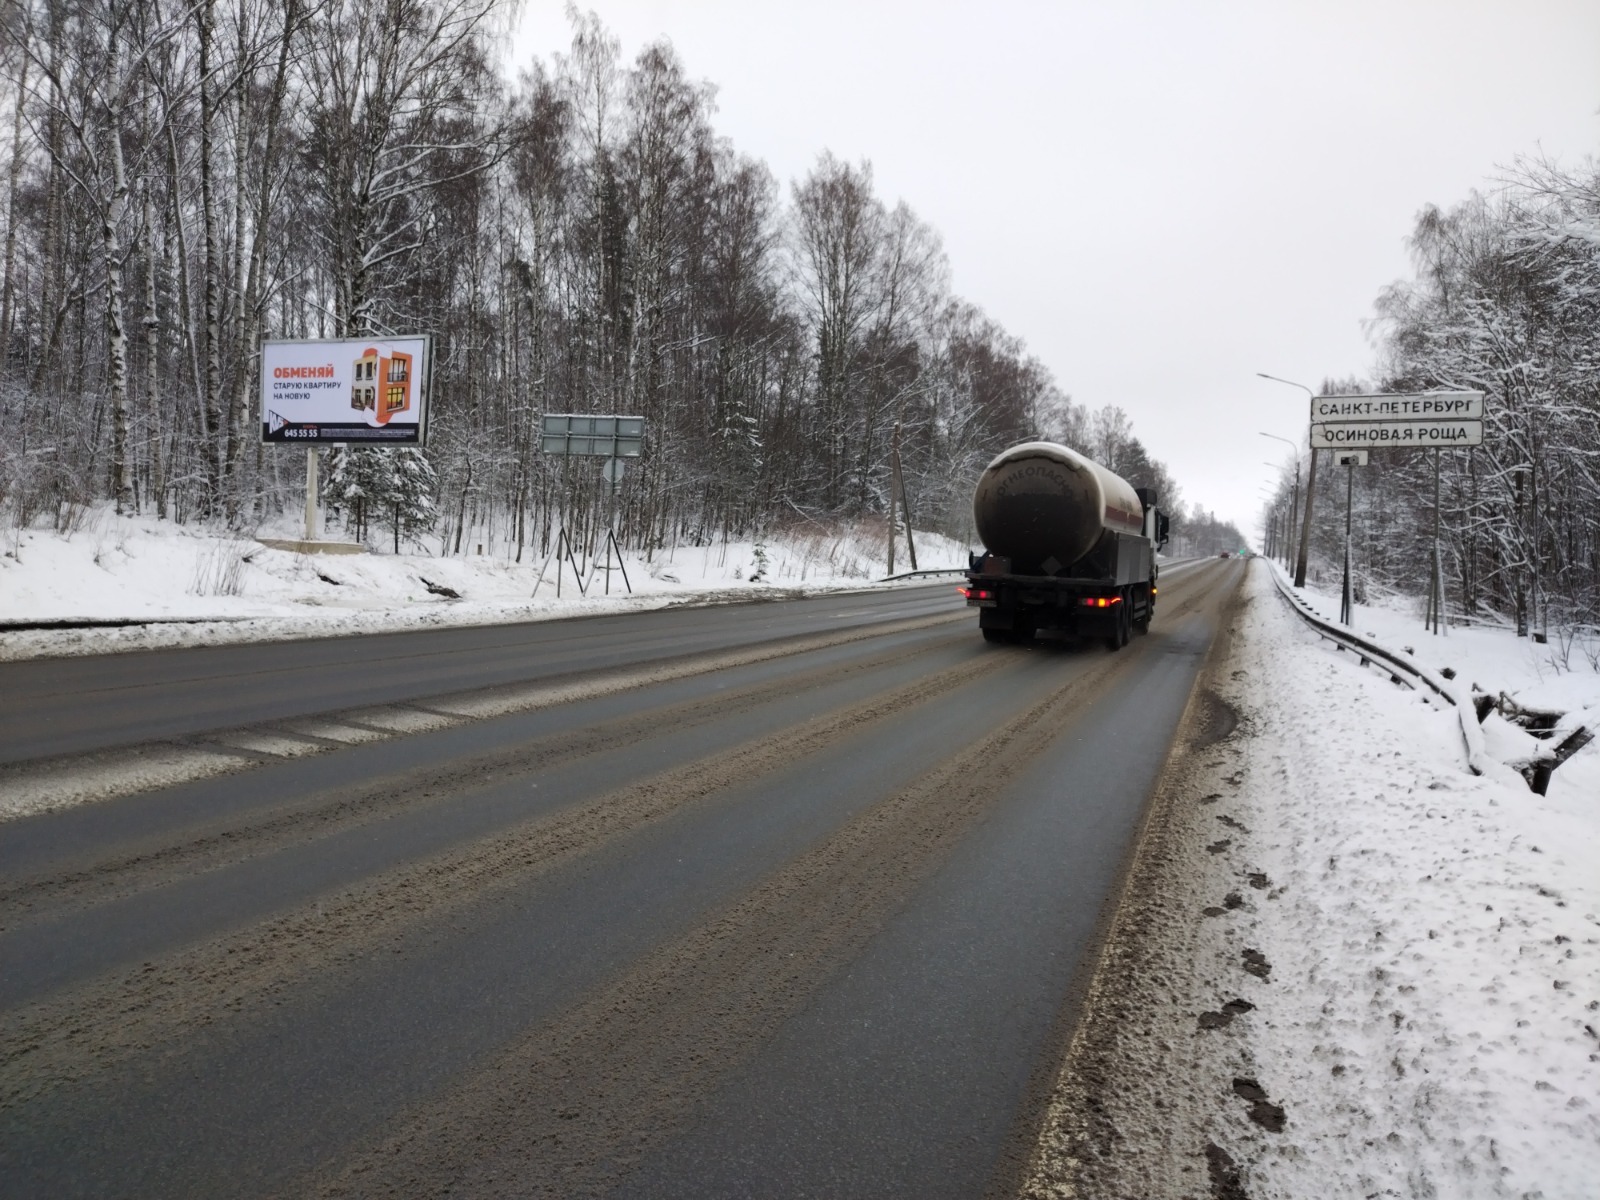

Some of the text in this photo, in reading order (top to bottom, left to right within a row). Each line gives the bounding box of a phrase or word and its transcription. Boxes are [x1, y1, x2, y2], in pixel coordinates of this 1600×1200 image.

[273, 364, 335, 379] ОБМЕНЯЙ
[273, 381, 341, 390] СТАРУЮ КВАРТИРУ
[1319, 400, 1474, 415] САНКТ-ПЕТЕРБУРГ
[284, 429, 298, 438] 645
[298, 429, 308, 438] 55
[308, 429, 318, 438] 55
[1325, 428, 1468, 442] ОСИНОВАЯ РОЩА
